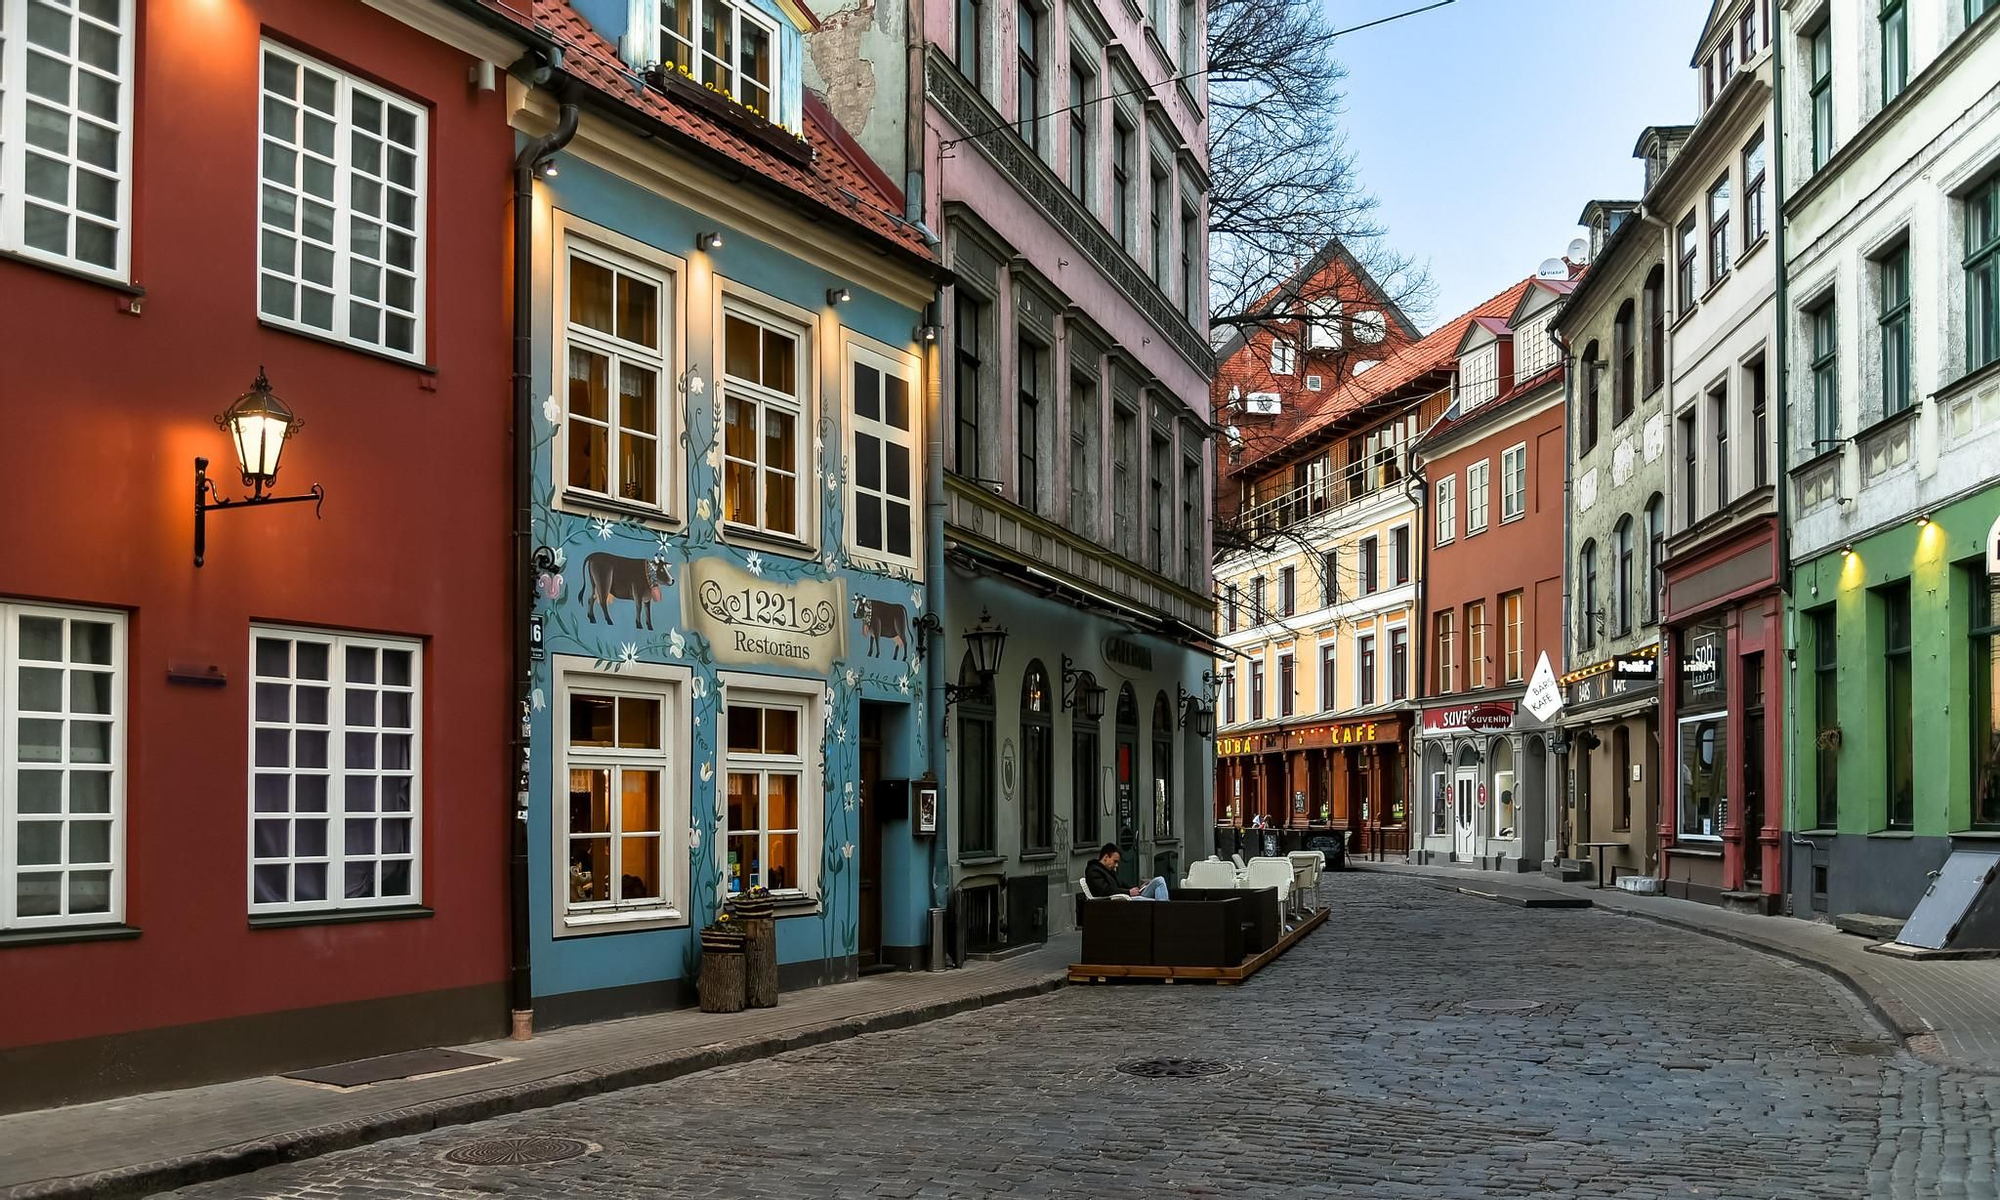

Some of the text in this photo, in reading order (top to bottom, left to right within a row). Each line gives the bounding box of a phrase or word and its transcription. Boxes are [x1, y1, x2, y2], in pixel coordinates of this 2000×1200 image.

[741, 588, 801, 629] 1221
[734, 629, 810, 660] Restorāns
[1217, 724, 1376, 755] CUBA CAFE
